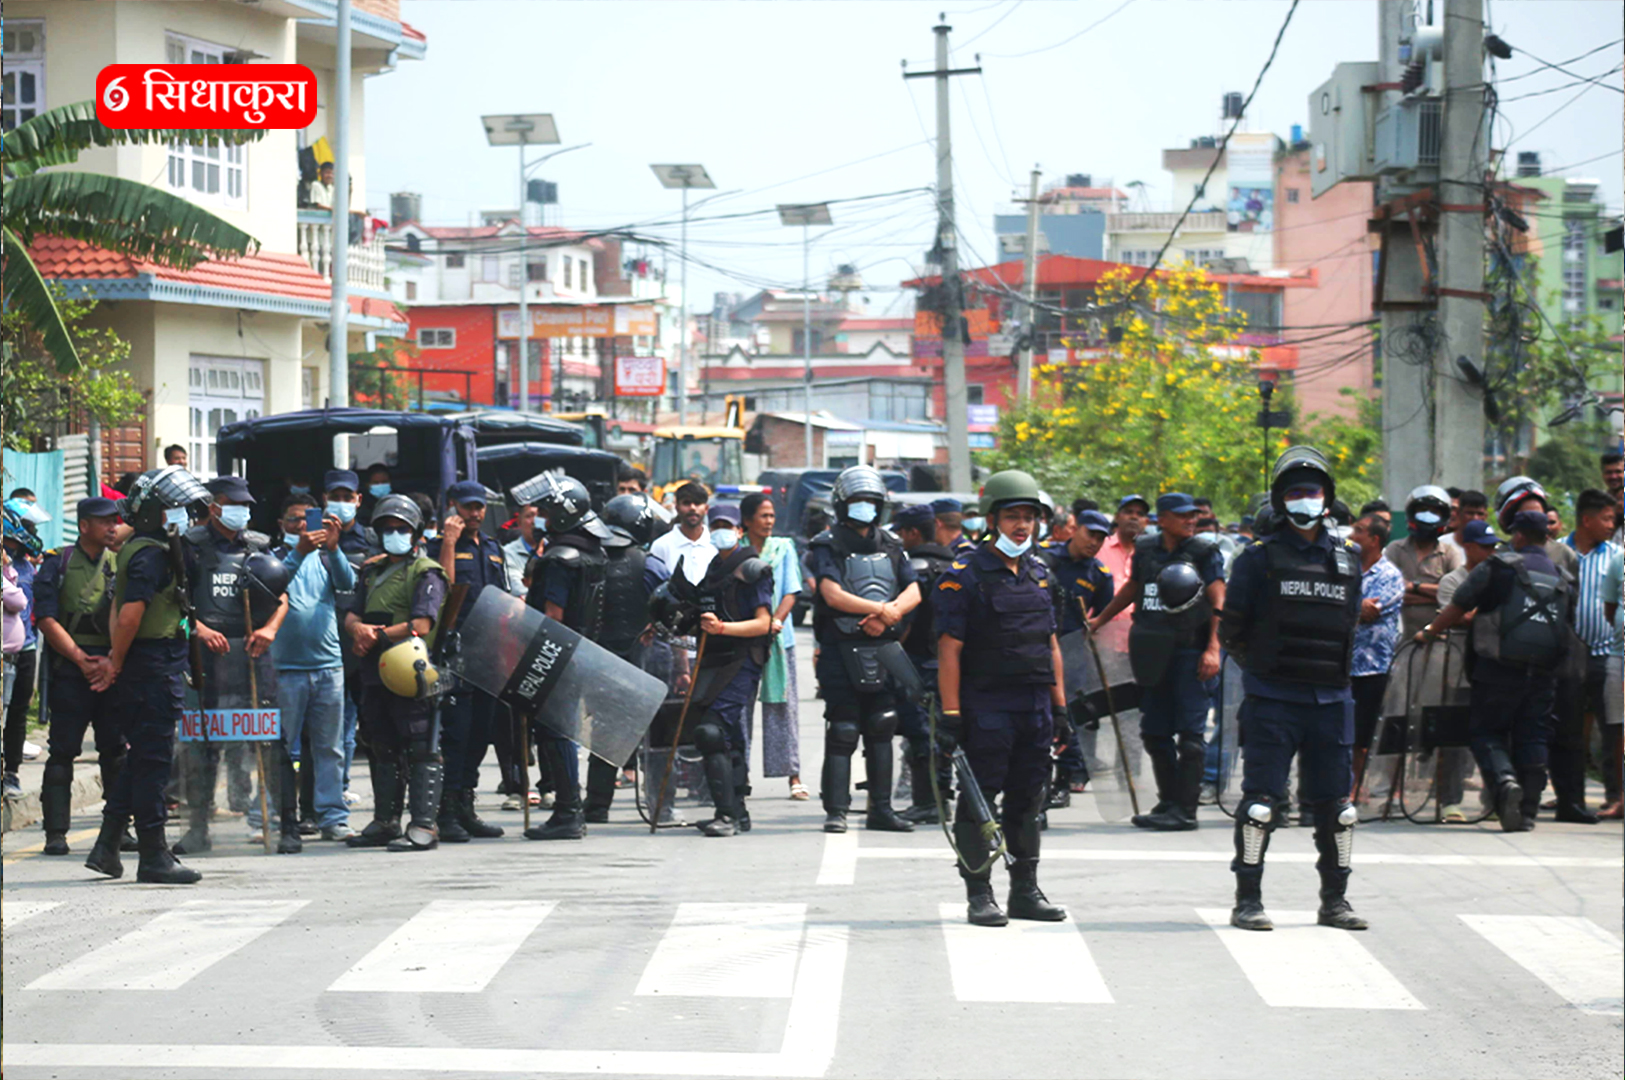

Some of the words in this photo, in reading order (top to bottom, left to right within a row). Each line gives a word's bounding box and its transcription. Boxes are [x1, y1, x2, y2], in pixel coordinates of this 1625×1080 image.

[212, 573, 241, 585] NEP
[212, 586, 239, 597] POL
[1280, 581, 1312, 596] NEPAL
[1314, 582, 1345, 600] POLICE
[517, 671, 545, 700] NEPAL
[531, 639, 562, 676] POLICE
[181, 713, 228, 737] NEPAL
[232, 712, 277, 736] POLICE
